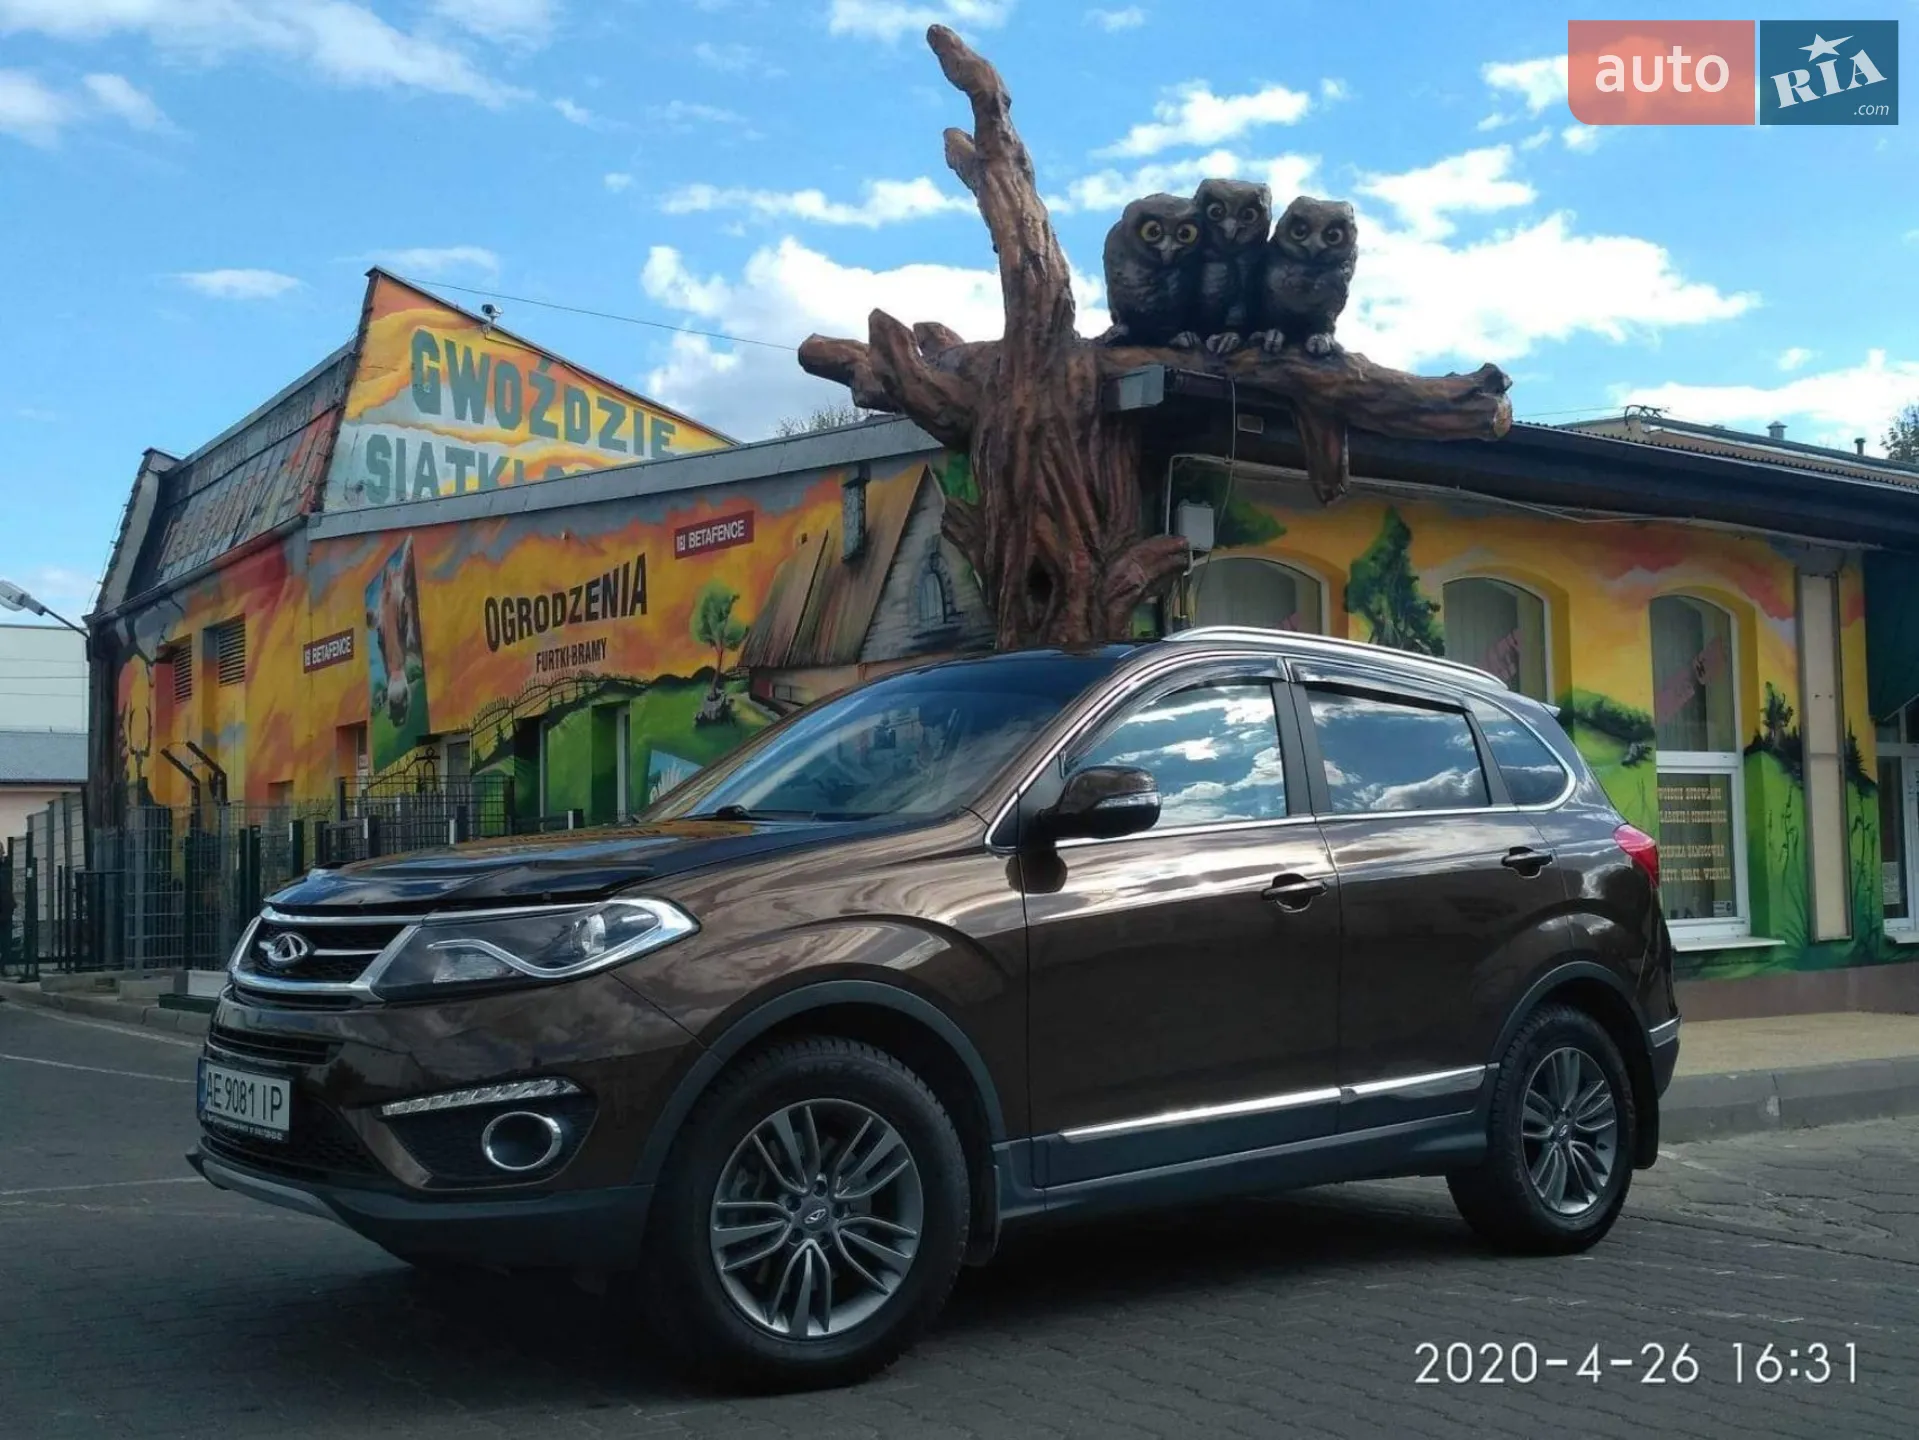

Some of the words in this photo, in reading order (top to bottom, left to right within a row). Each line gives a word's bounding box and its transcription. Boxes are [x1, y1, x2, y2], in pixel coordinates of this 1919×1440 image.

[411, 328, 677, 459] GWOŹDZIE
[688, 519, 745, 549] BETAFENCE
[484, 552, 648, 653] OGRODZENIA
[312, 635, 352, 665] BETAFENCE
[206, 1071, 223, 1109] AE
[225, 1076, 255, 1118] 9081
[262, 1084, 283, 1122] IP
